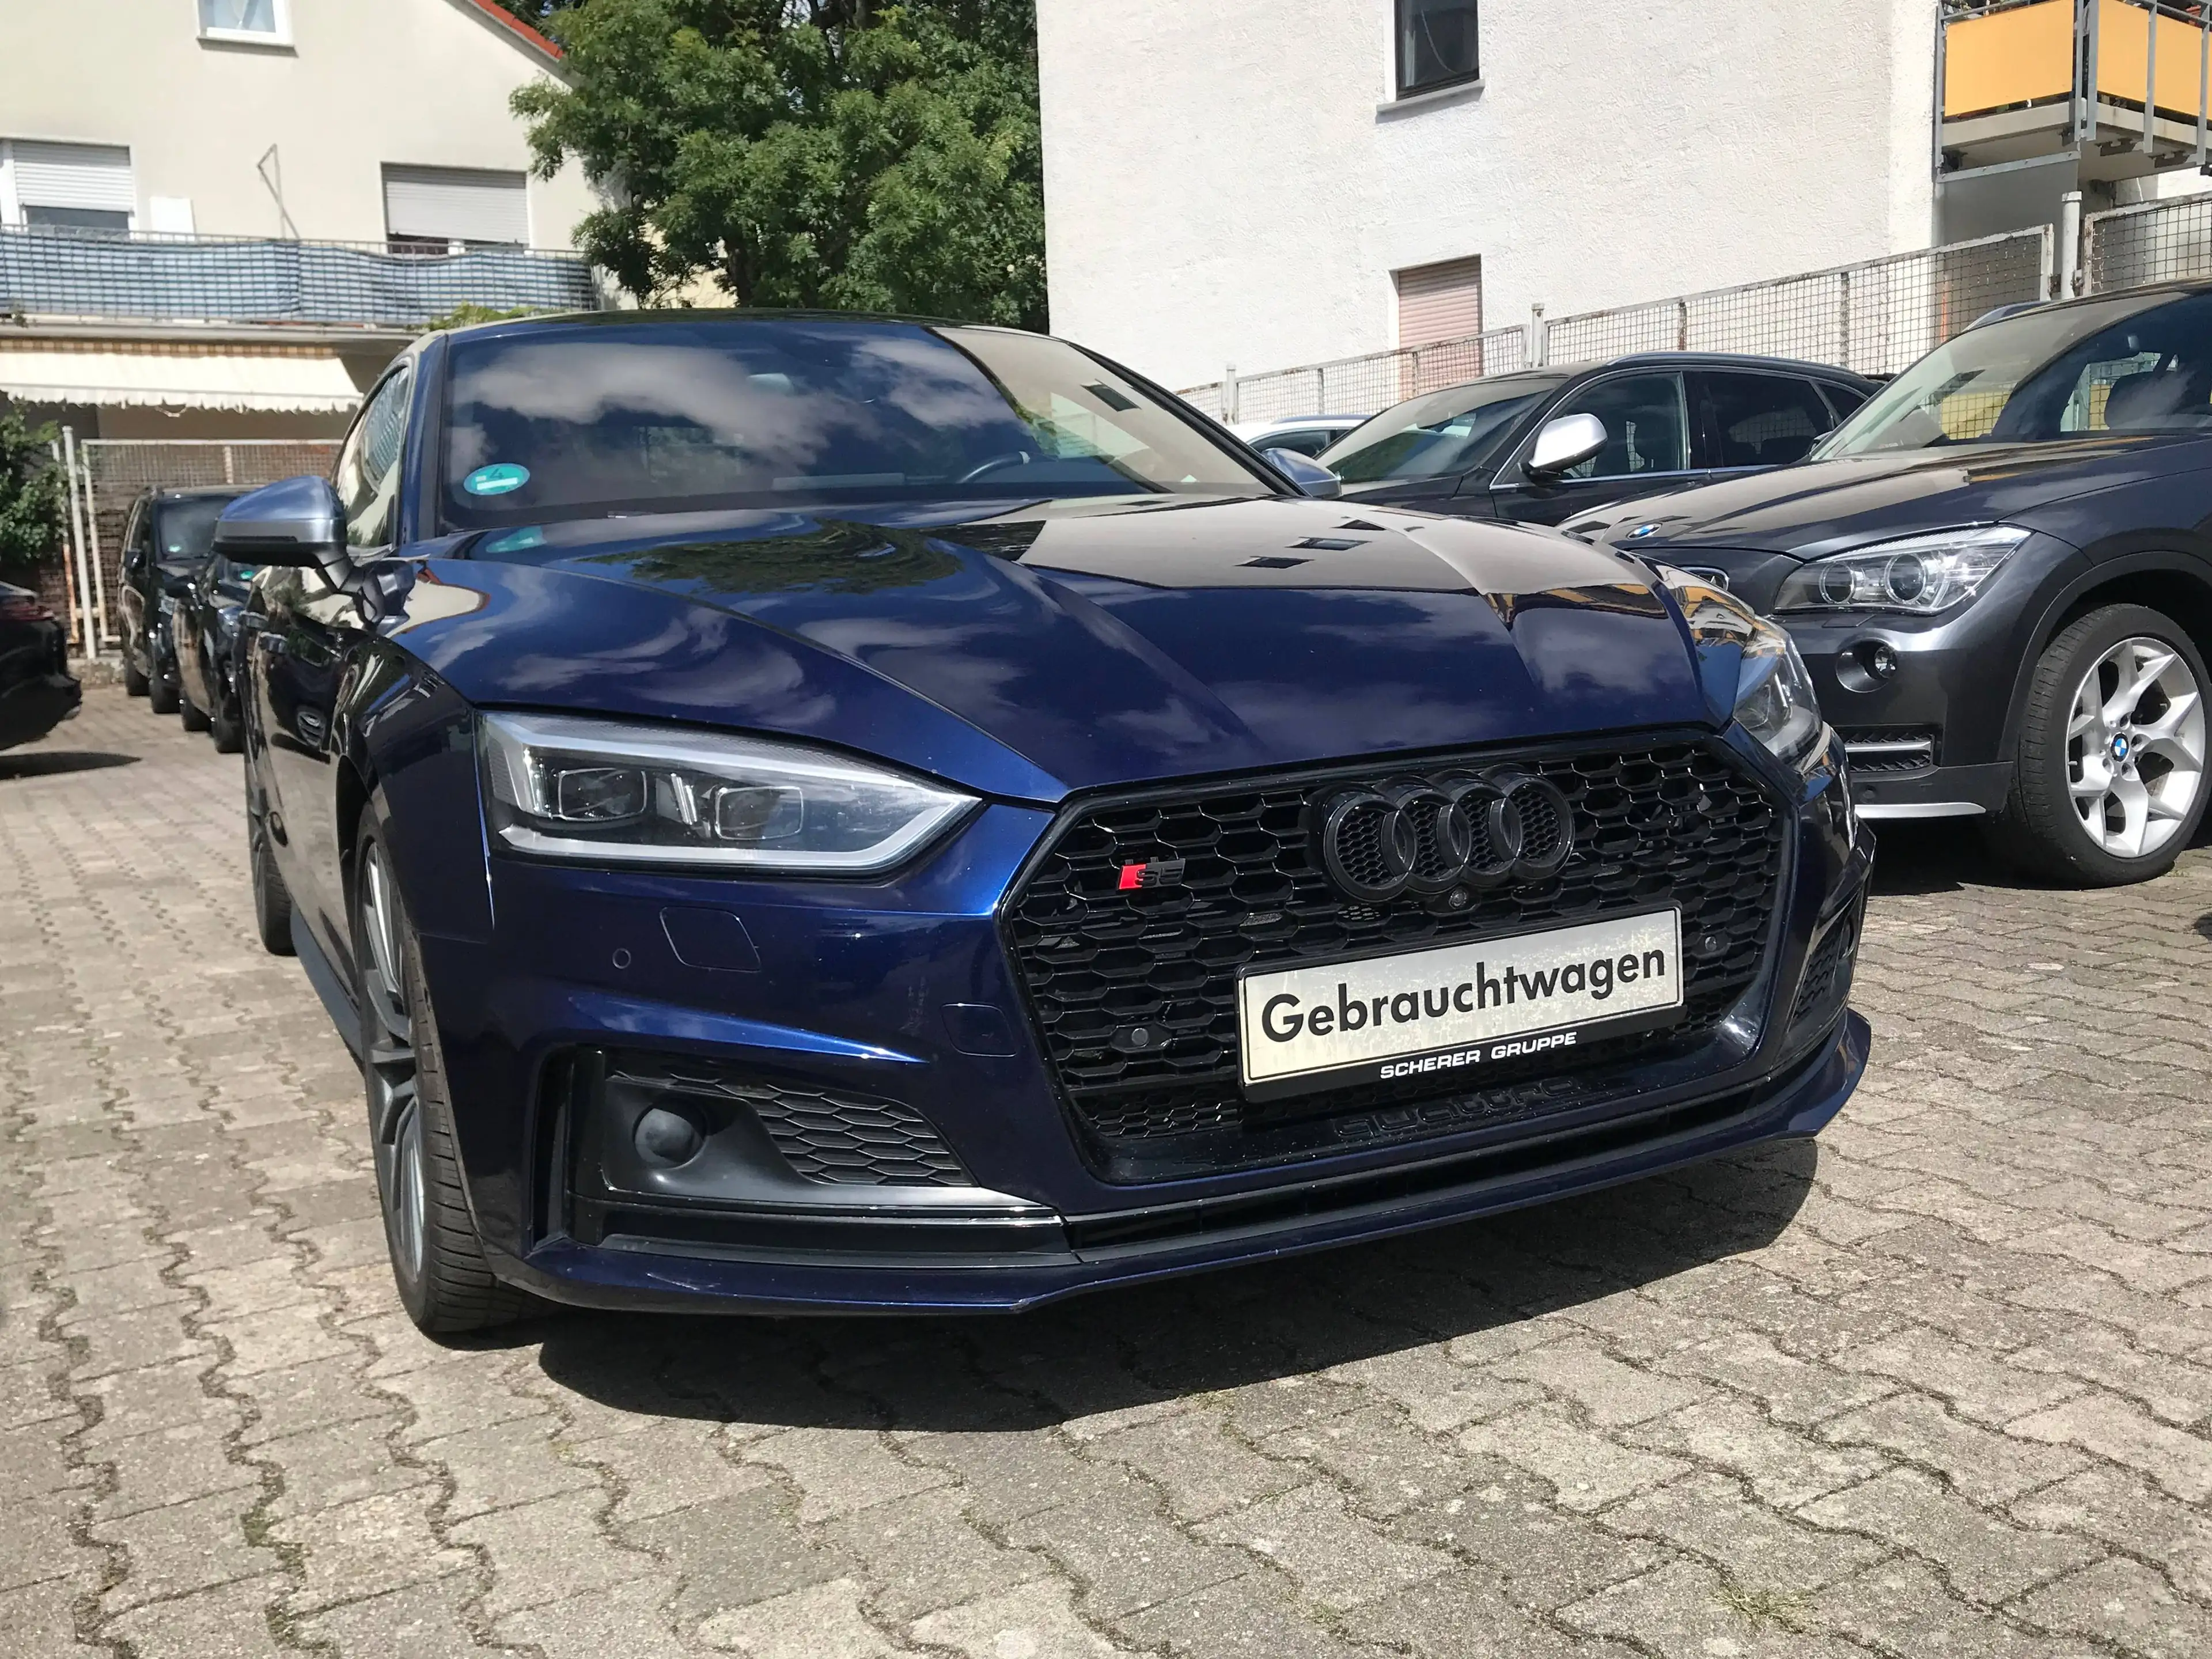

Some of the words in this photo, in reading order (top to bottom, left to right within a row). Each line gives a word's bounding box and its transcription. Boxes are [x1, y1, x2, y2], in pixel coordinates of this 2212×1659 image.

[489, 468, 504, 480] 4
[1262, 949, 1665, 1043] Gebrauchtwagen
[1380, 1050, 1480, 1079] SCHERER
[1491, 1031, 1577, 1059] GRUPPE
[1334, 1076, 1579, 1138] quattro
